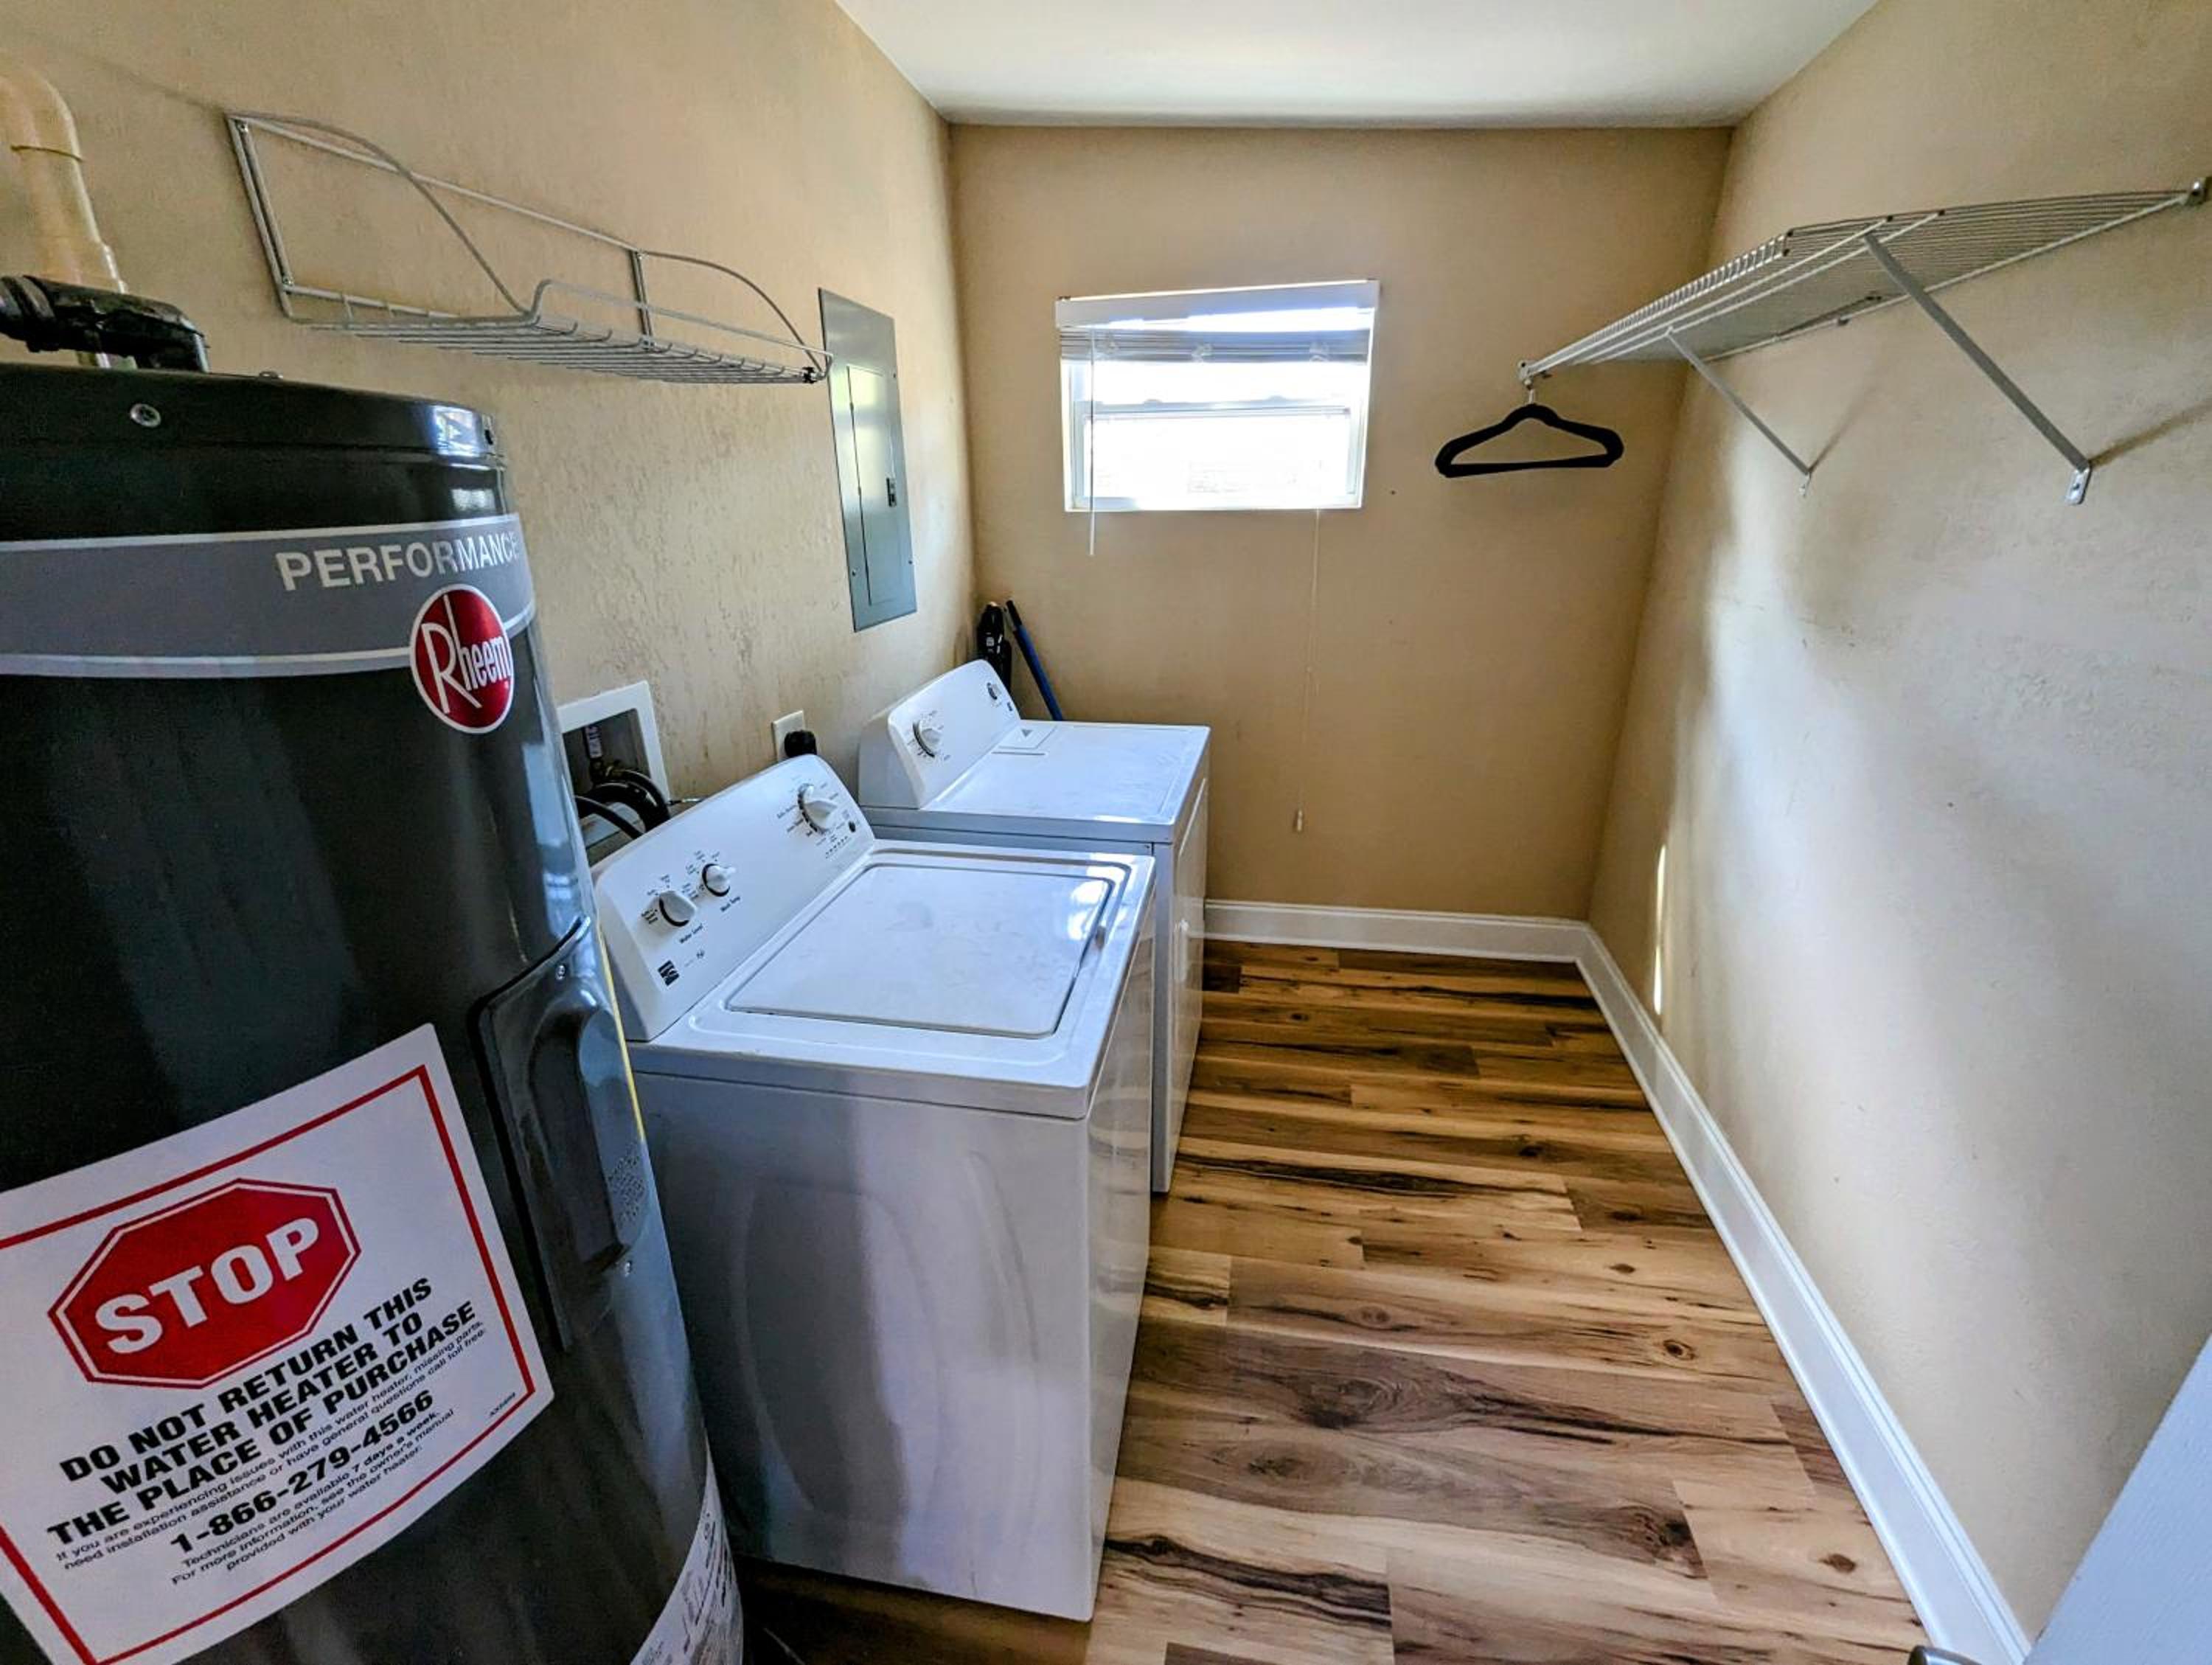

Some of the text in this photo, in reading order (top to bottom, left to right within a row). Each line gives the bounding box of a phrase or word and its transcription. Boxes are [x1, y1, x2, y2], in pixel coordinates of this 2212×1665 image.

[421, 594, 510, 715] Rheem
[94, 1216, 319, 1355] STOP
[46, 1501, 131, 1545] THE
[136, 1439, 262, 1511] PLACE
[268, 1407, 313, 1446] OF
[322, 1300, 476, 1415] PURCHASE
[57, 1551, 67, 1561] If
[72, 1540, 100, 1557] you
[105, 1529, 129, 1543] are
[133, 1483, 228, 1531] experiencing
[229, 1458, 276, 1484] issues
[278, 1439, 307, 1459] with
[308, 1423, 333, 1442] this
[335, 1401, 369, 1425] water
[414, 1342, 455, 1374] missing
[59, 1277, 432, 1482] DO NOT RETURN THIS
[64, 1550, 104, 1570] need
[106, 1515, 187, 1554] installation
[191, 1474, 266, 1517] assistance
[269, 1464, 283, 1475] or
[287, 1444, 319, 1466] have
[322, 1411, 369, 1447] general
[371, 1374, 426, 1414] questions
[428, 1358, 447, 1375] call
[448, 1344, 463, 1360] toll
[100, 1312, 423, 1495] WATER HEATER TO
[170, 1389, 434, 1553] 1-866-279-4566
[172, 1568, 195, 1585] For
[200, 1549, 237, 1571] more
[321, 1487, 344, 1504] see
[347, 1473, 367, 1487] the
[369, 1440, 414, 1473] owner's
[415, 1408, 453, 1442] manual
[183, 1523, 265, 1567] Technicians
[269, 1509, 291, 1525] are
[293, 1473, 350, 1509] available
[352, 1462, 361, 1473] 7
[364, 1443, 394, 1467] days
[396, 1436, 405, 1445] a
[226, 1533, 286, 1571] provided
[288, 1517, 315, 1534] with
[317, 1497, 345, 1520] your
[348, 1473, 380, 1498] water
